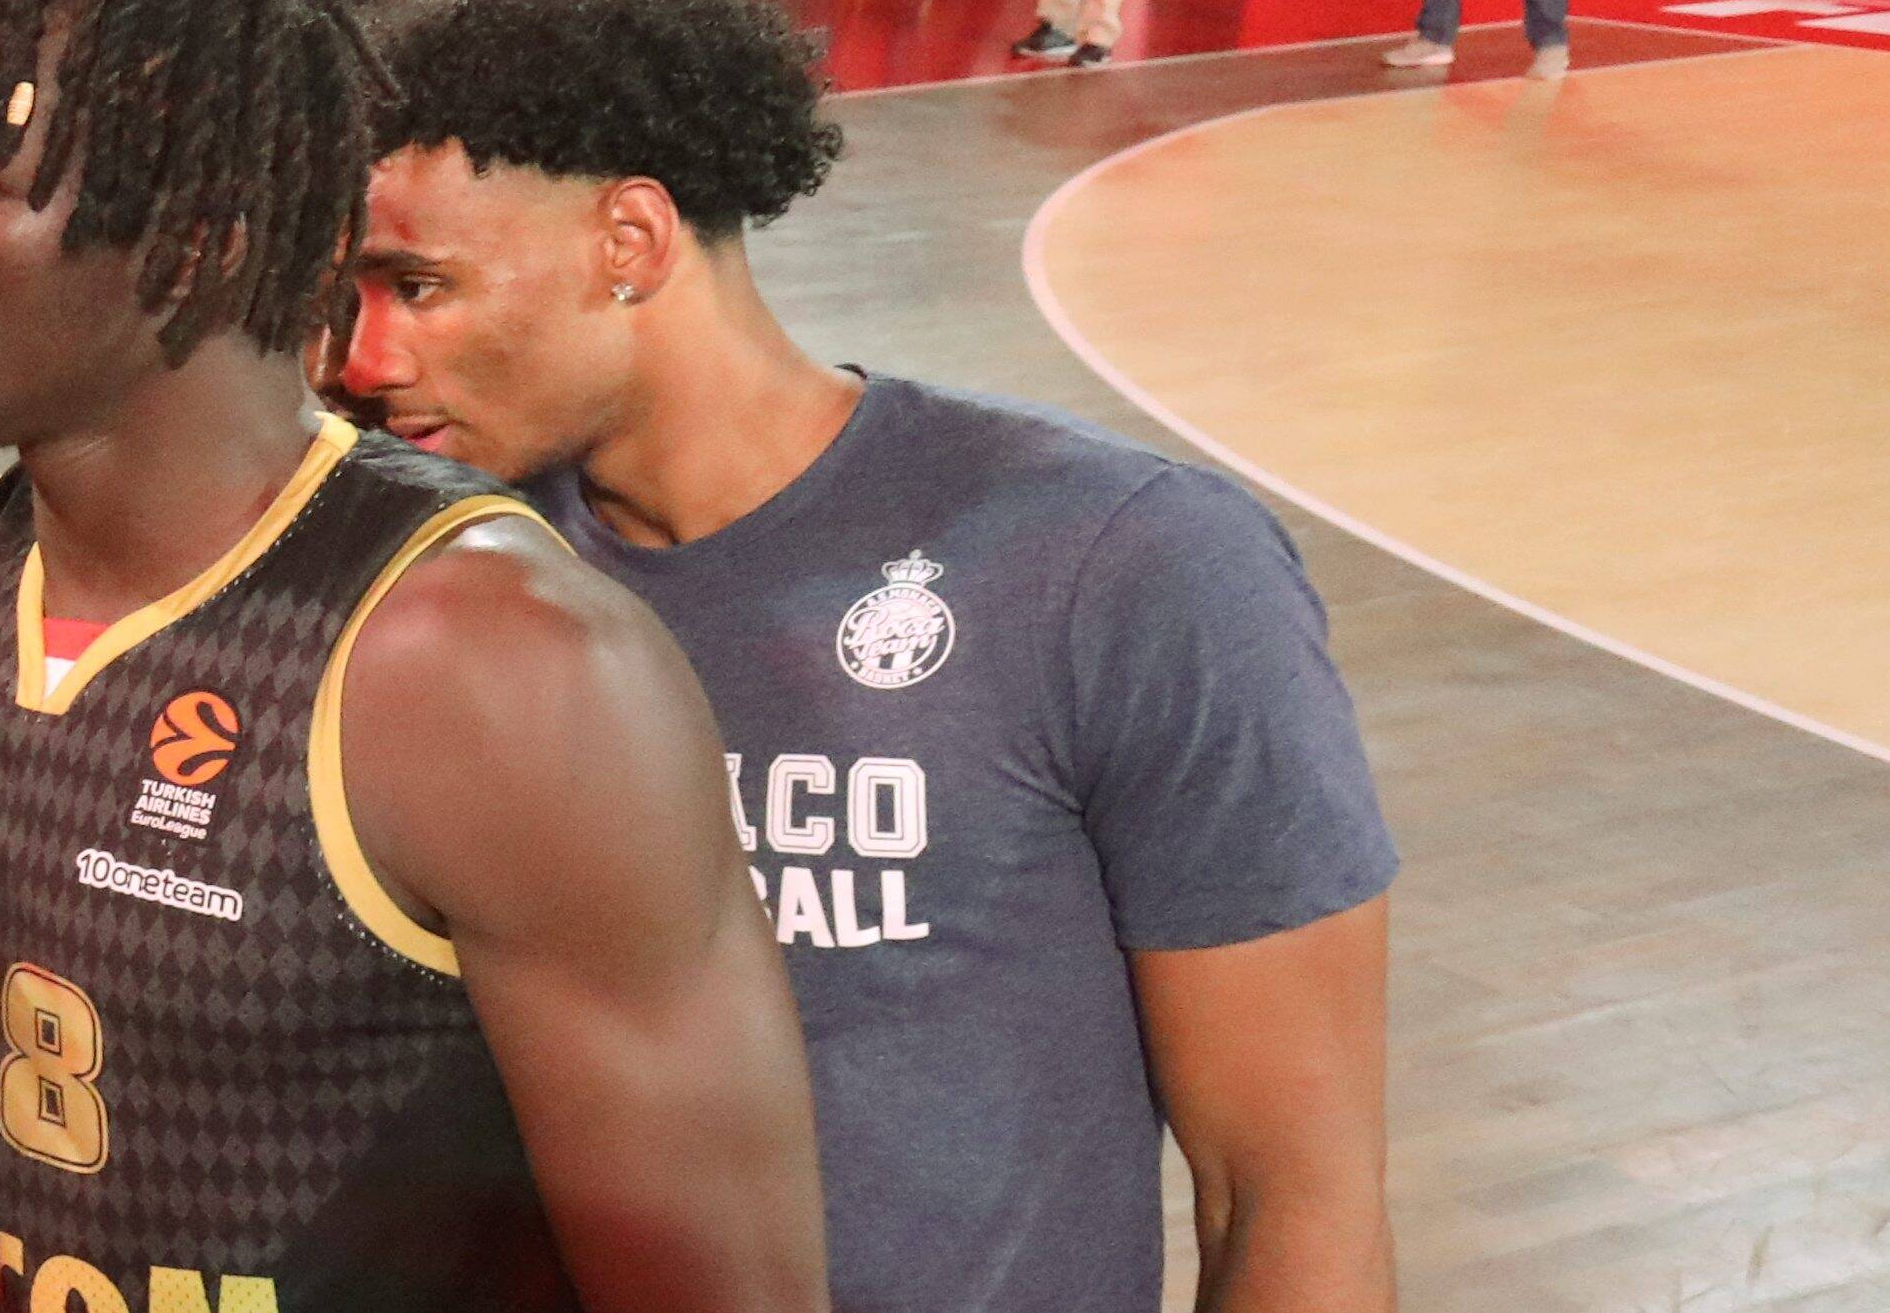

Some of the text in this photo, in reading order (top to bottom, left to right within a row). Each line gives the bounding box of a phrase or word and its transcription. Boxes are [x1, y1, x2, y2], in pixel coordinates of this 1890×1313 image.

[135, 794, 212, 826] AIRLINES
[141, 778, 217, 810] TURKISH
[130, 809, 208, 840] EuroLeague
[749, 866, 931, 949] ALL
